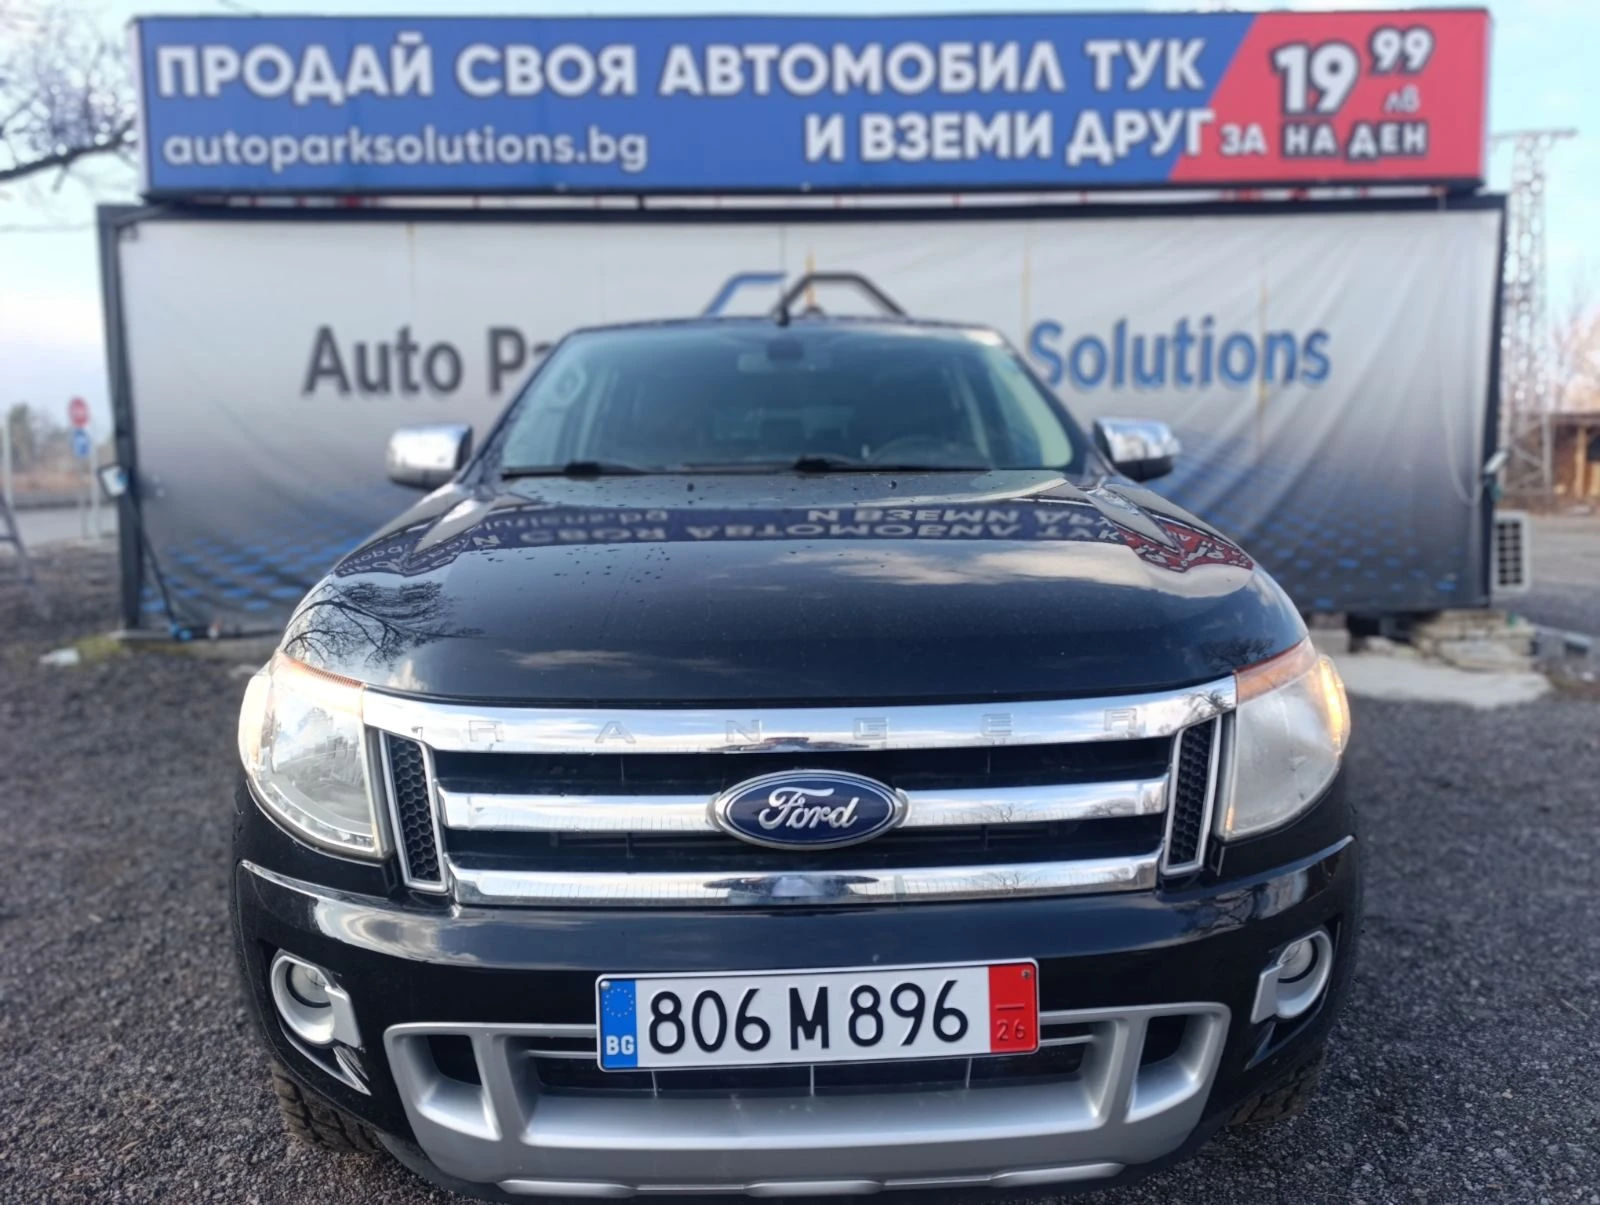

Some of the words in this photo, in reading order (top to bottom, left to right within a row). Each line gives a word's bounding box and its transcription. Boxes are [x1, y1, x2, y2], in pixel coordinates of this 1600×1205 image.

[156, 31, 434, 106] ПРОДАЙ
[456, 44, 637, 98] СВОЯ
[659, 40, 1066, 96] АВТОМОБИЛ
[1085, 38, 1205, 92] ТУК
[1370, 27, 1434, 74] 99
[1274, 42, 1359, 114] 19
[163, 125, 650, 173] autoparksolutions.bg
[805, 112, 845, 162] И
[860, 111, 1053, 161] ВЗЕМИ
[1065, 109, 1215, 166] ДРУГ
[1219, 124, 1268, 156] ЗА
[1282, 122, 1337, 156] НА
[1348, 121, 1428, 159] ДЕН
[303, 325, 464, 395] Auto
[1029, 316, 1331, 388] Solutions
[758, 787, 858, 830] Ford
[648, 987, 772, 1056] 806
[788, 986, 831, 1051] M
[847, 979, 969, 1048] 896
[996, 1018, 1026, 1042] 26
[605, 1034, 635, 1056] BG
